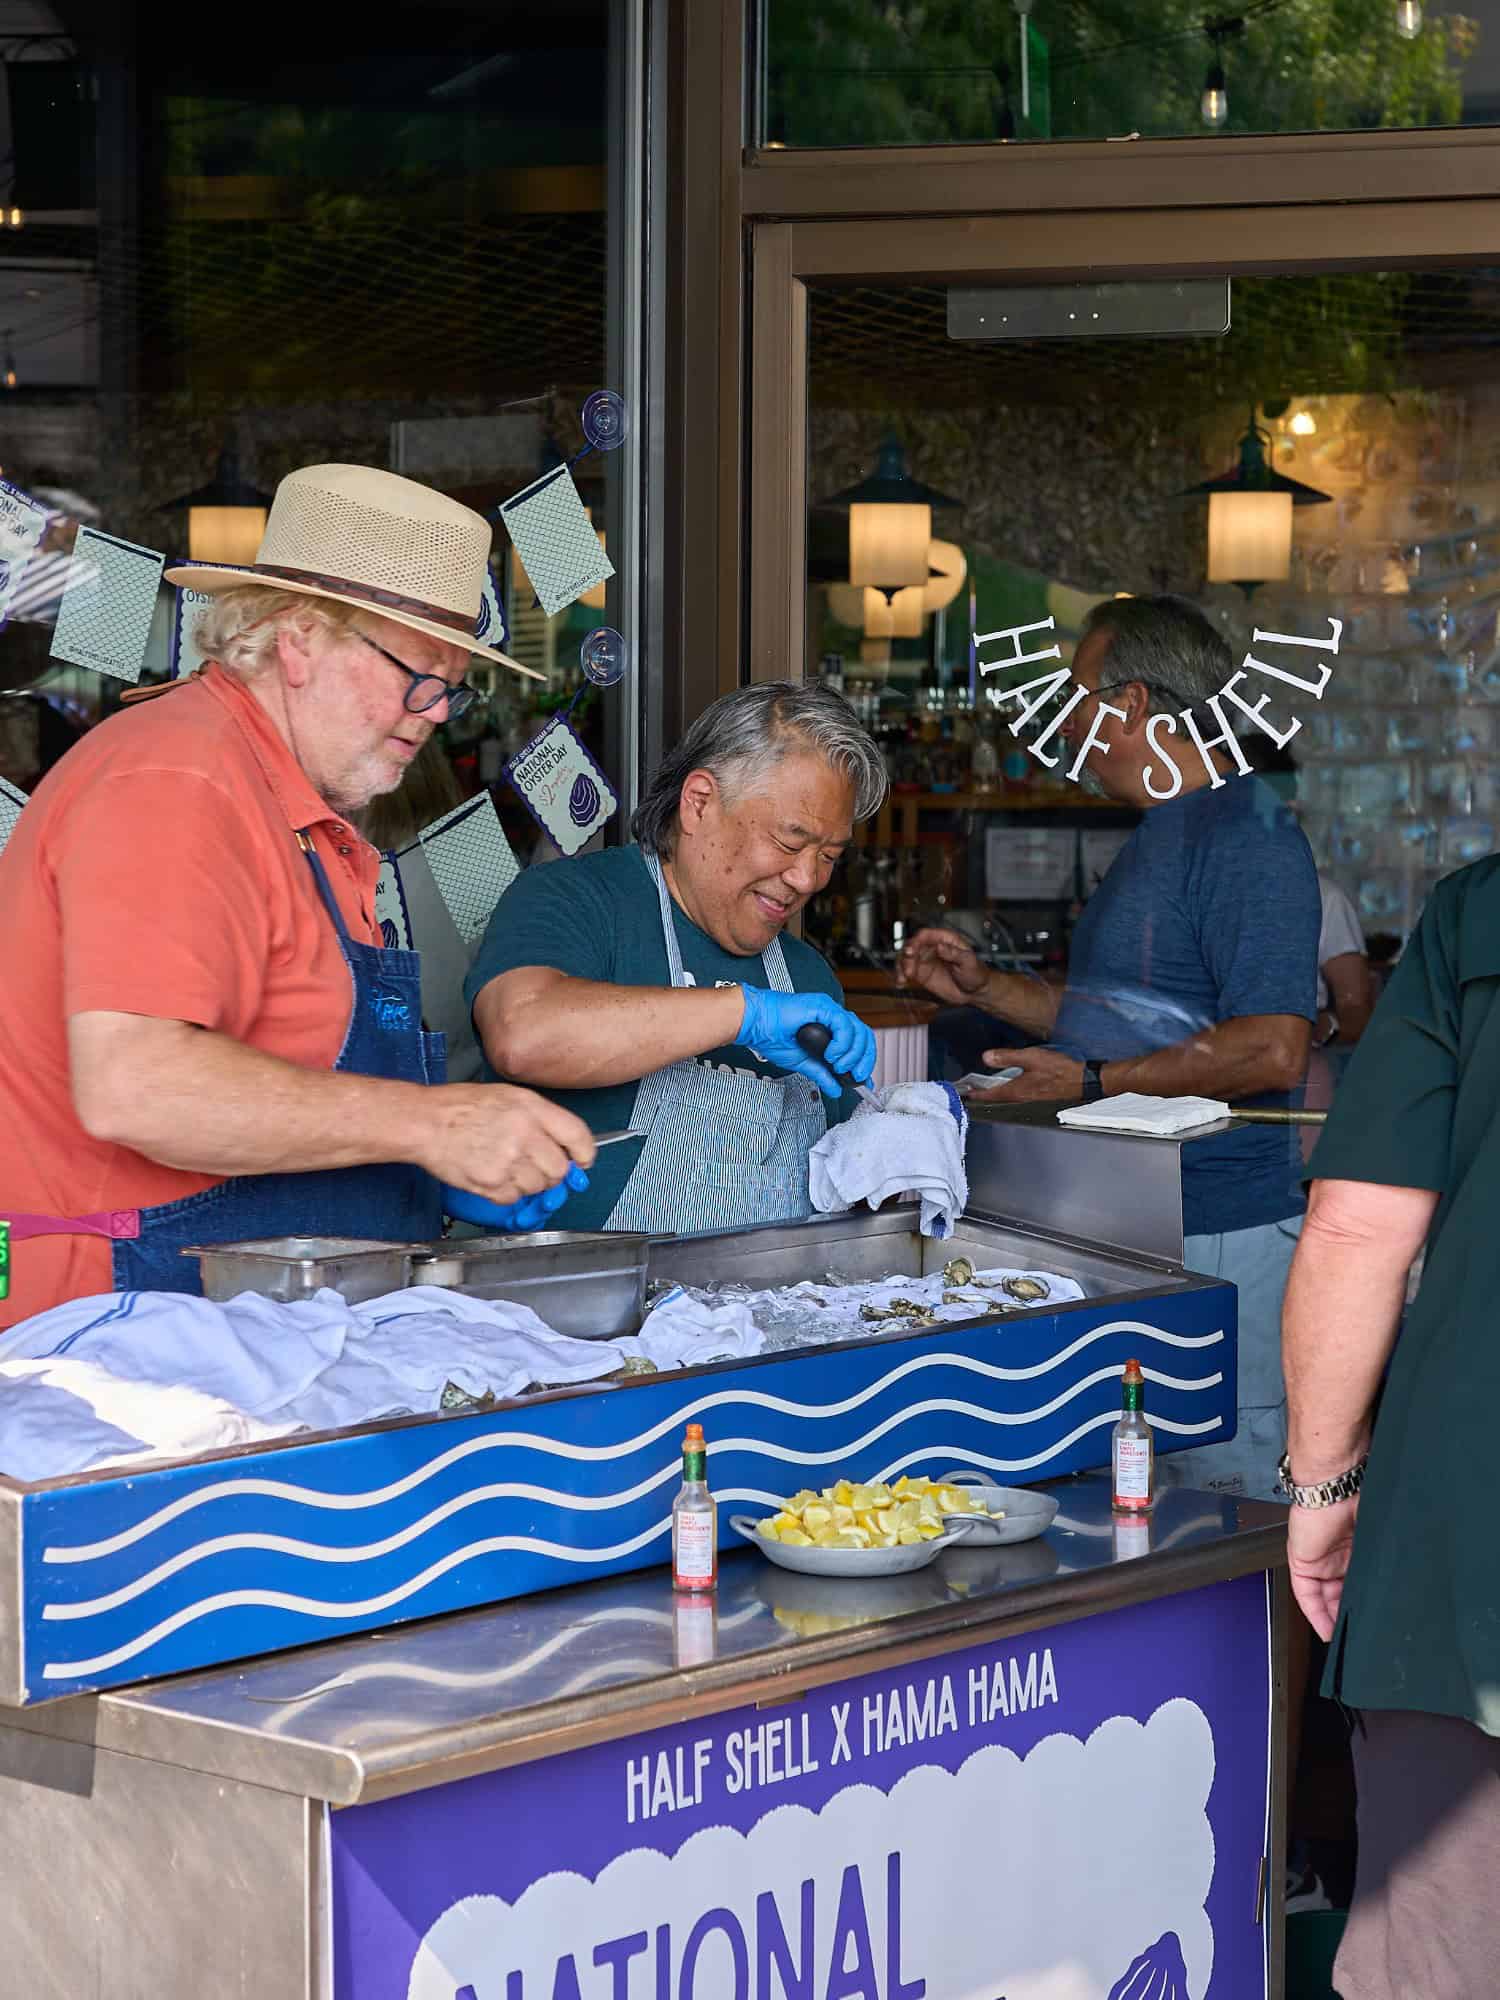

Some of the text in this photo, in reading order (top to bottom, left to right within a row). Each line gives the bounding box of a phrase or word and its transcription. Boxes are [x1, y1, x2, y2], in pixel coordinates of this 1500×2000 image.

[516, 742, 556, 783] NATIONAL
[973, 615, 1344, 800] HALF SHELL
[523, 760, 555, 792] OYSTER
[551, 743, 569, 765] DAY
[626, 1647, 1059, 1824] HALF SHELL X HAMA HAMA
